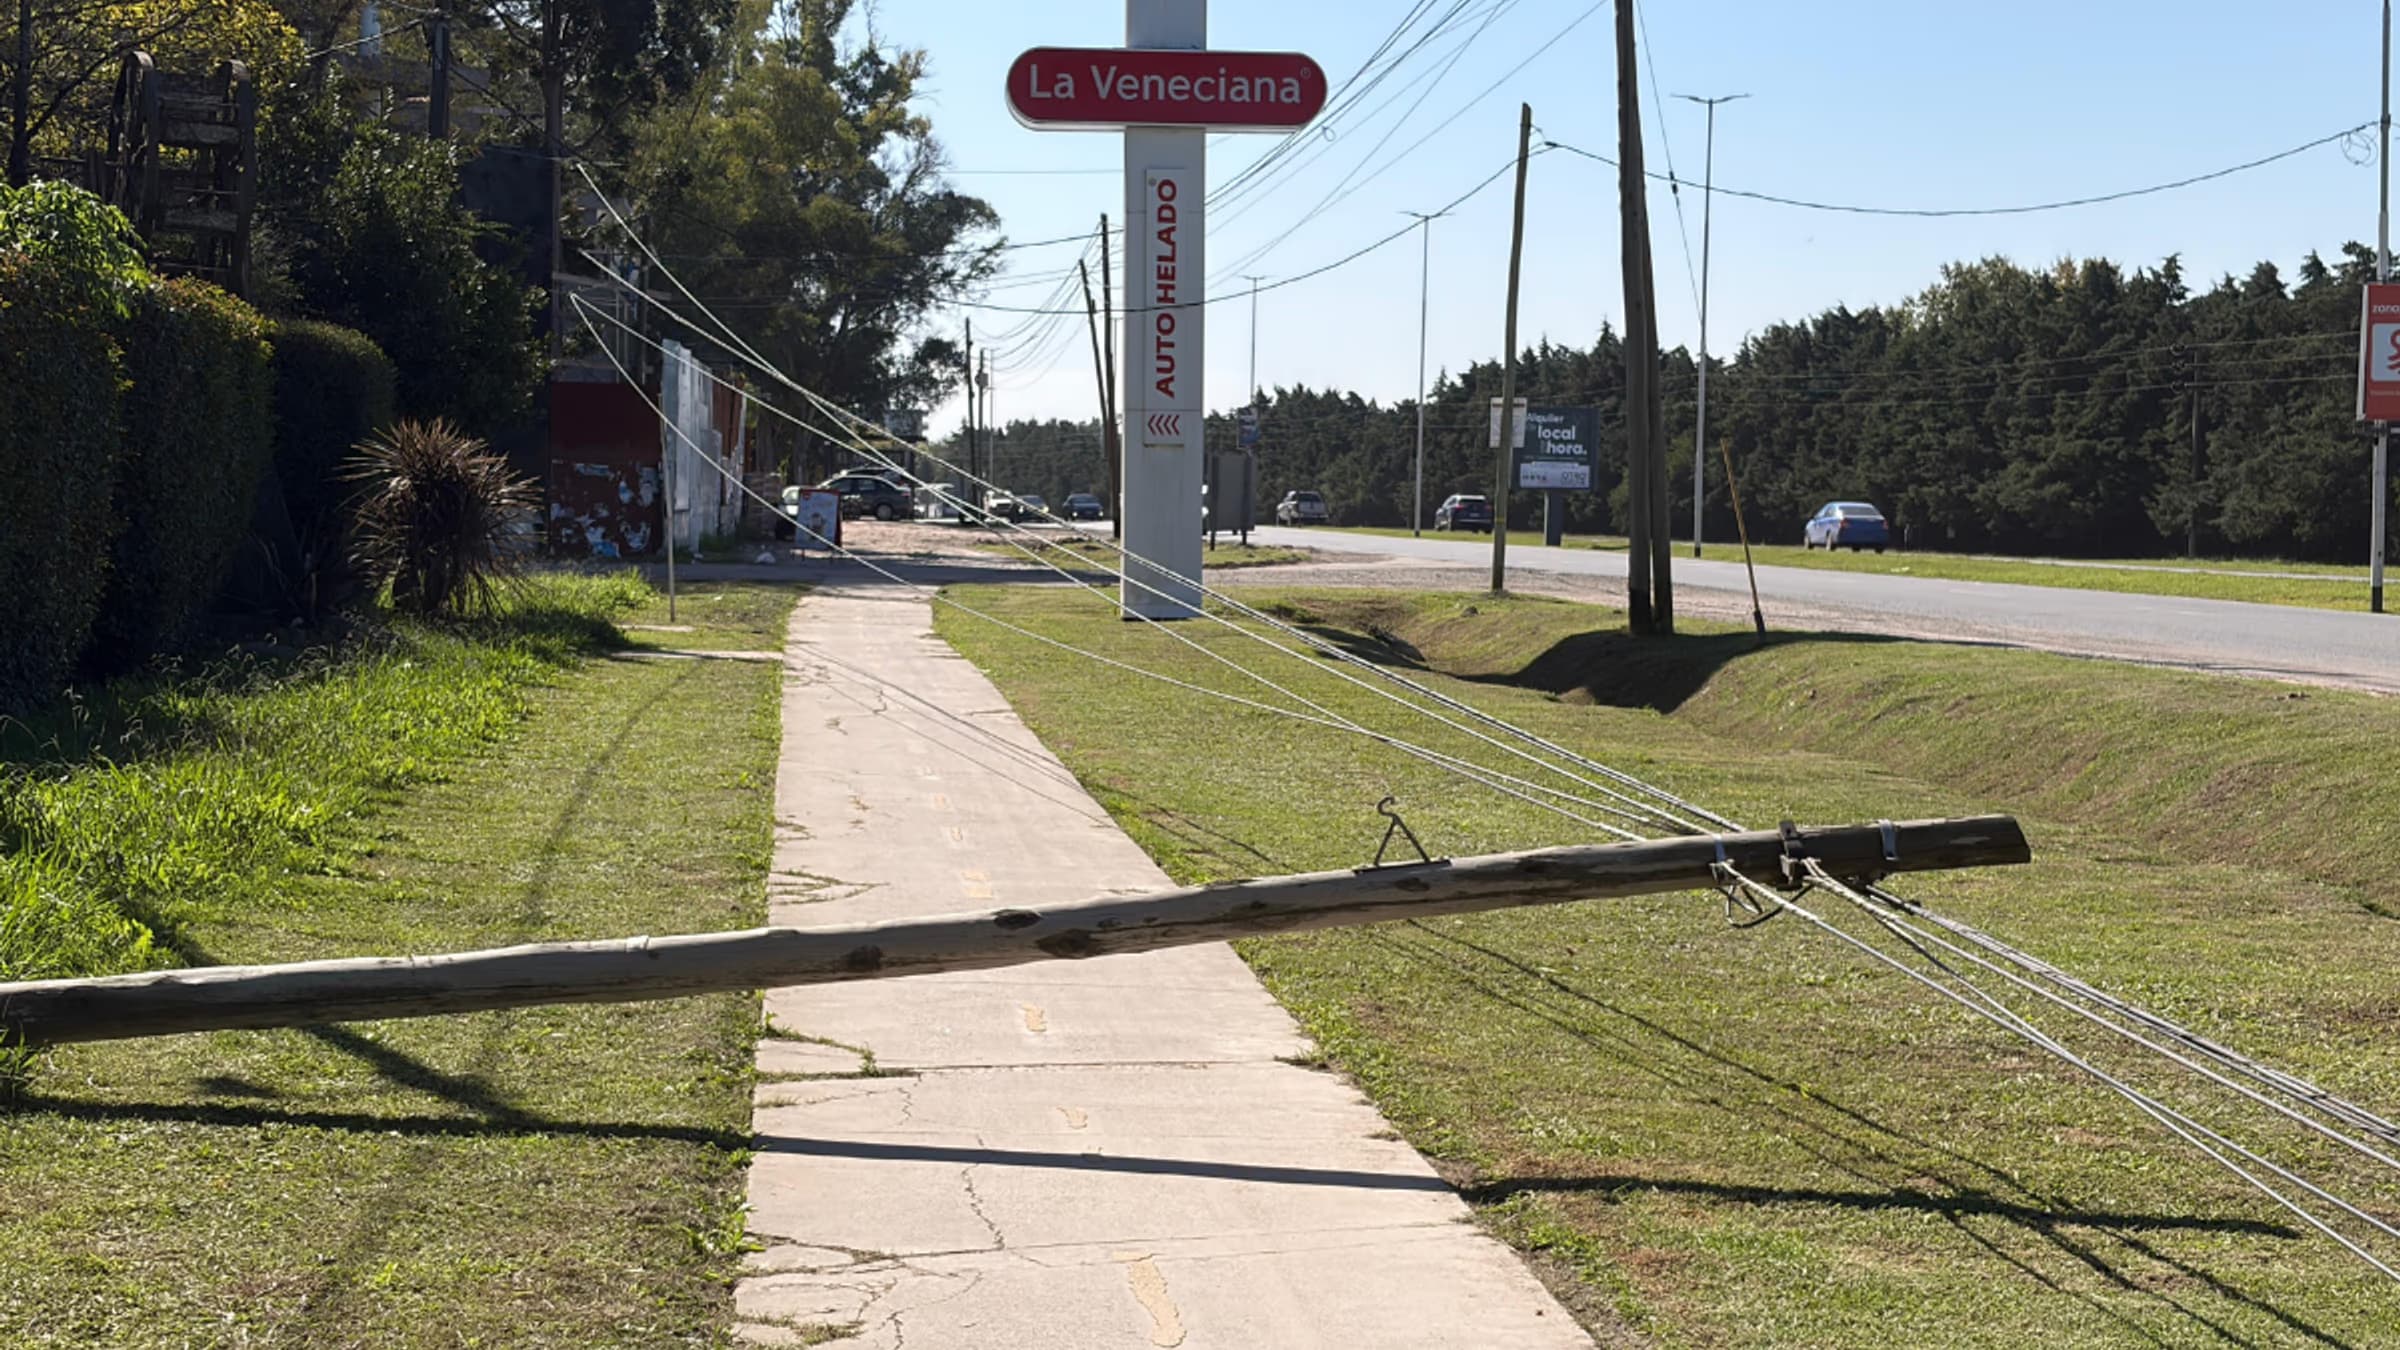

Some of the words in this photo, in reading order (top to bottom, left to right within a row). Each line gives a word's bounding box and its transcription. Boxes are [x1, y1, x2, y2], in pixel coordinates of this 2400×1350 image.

[1029, 63, 1075, 99] La
[1090, 65, 1301, 104] Veneciana
[1156, 178, 1178, 304] HELADO
[1155, 312, 1176, 398] AUTO
[1538, 425, 1576, 440] local
[1545, 440, 1588, 455] hora.
